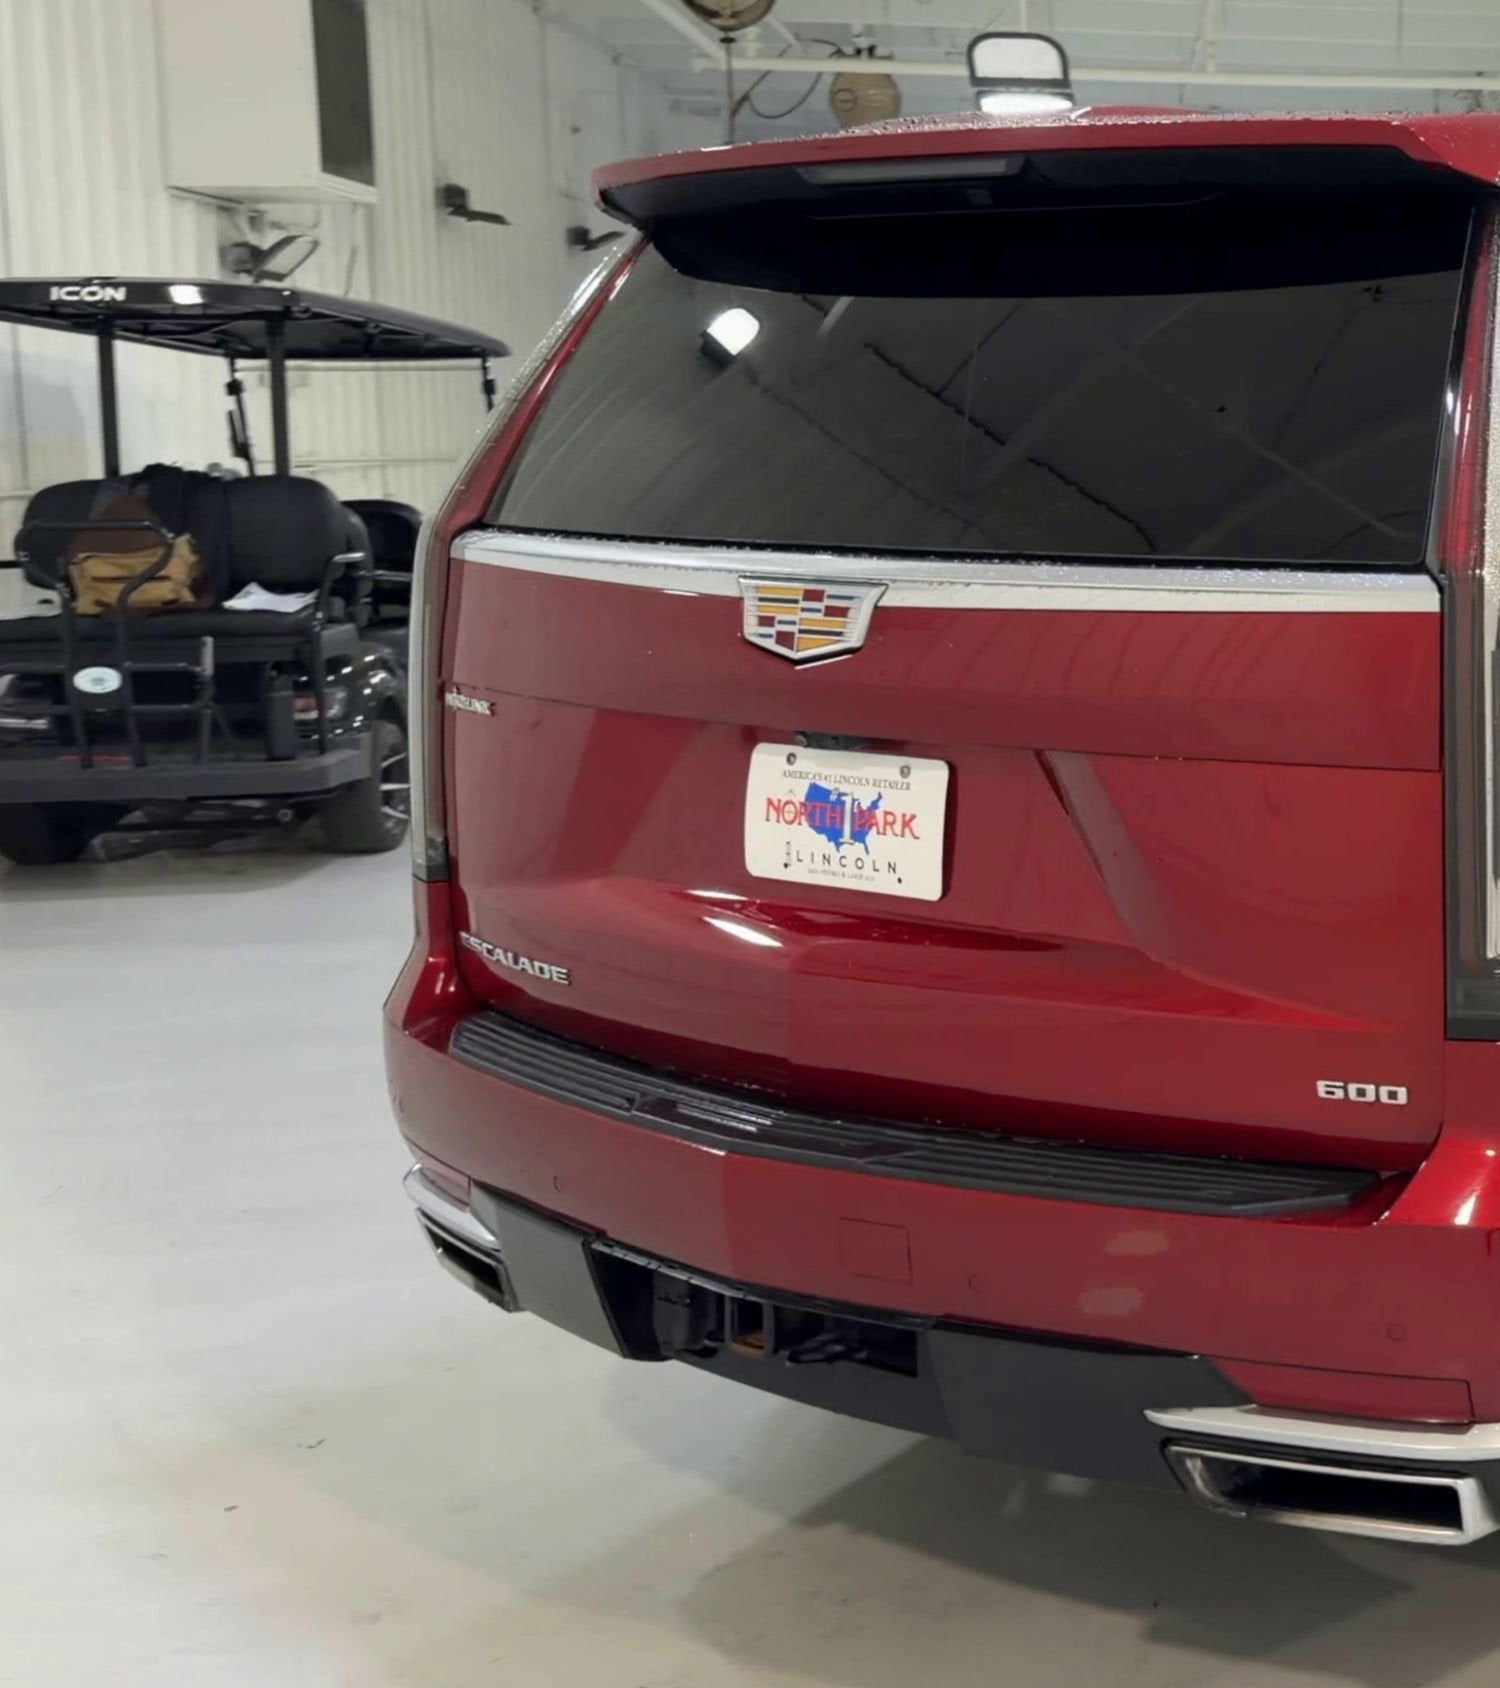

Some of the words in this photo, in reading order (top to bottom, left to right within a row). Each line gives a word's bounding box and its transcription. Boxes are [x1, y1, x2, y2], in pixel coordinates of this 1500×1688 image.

[49, 285, 127, 301] ICON
[833, 774, 871, 787] LINCOLN
[872, 779, 911, 791] RETAILER
[765, 797, 842, 829] NORTH
[854, 806, 920, 840] PARK
[796, 850, 897, 874] LINCOLN
[460, 931, 569, 985] ESCALADE
[1316, 1080, 1408, 1105] 600
